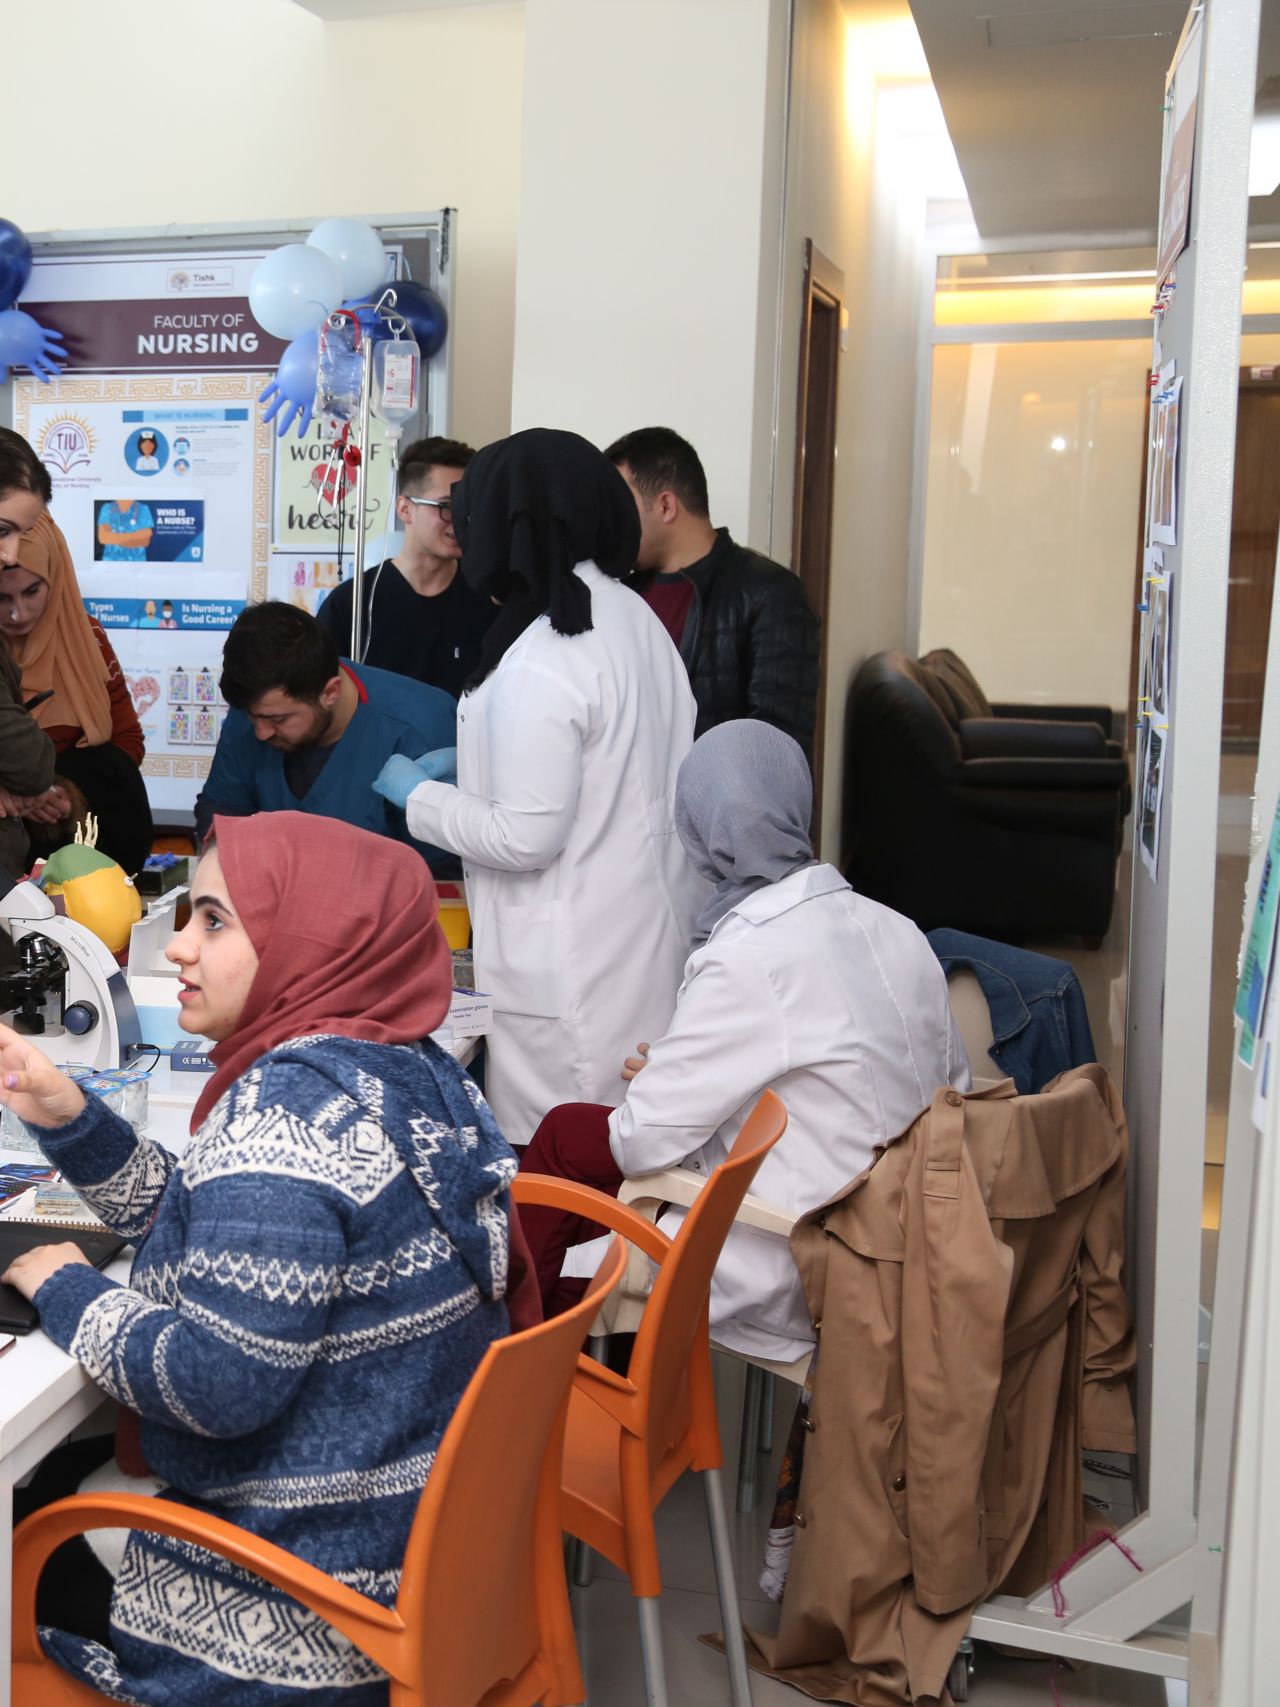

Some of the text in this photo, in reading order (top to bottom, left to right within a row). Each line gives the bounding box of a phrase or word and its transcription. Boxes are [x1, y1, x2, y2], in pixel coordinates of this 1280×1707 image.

[153, 313, 245, 329] FACULTY OF
[137, 332, 259, 355] NURSING
[57, 433, 77, 450] TIU
[156, 508, 186, 517] WHO IS
[156, 517, 195, 526] A NURSE?
[89, 602, 114, 614] Types
[182, 604, 190, 613] Is
[191, 604, 225, 615] Nursing
[100, 613, 129, 622] Nurses
[182, 615, 205, 624] Good
